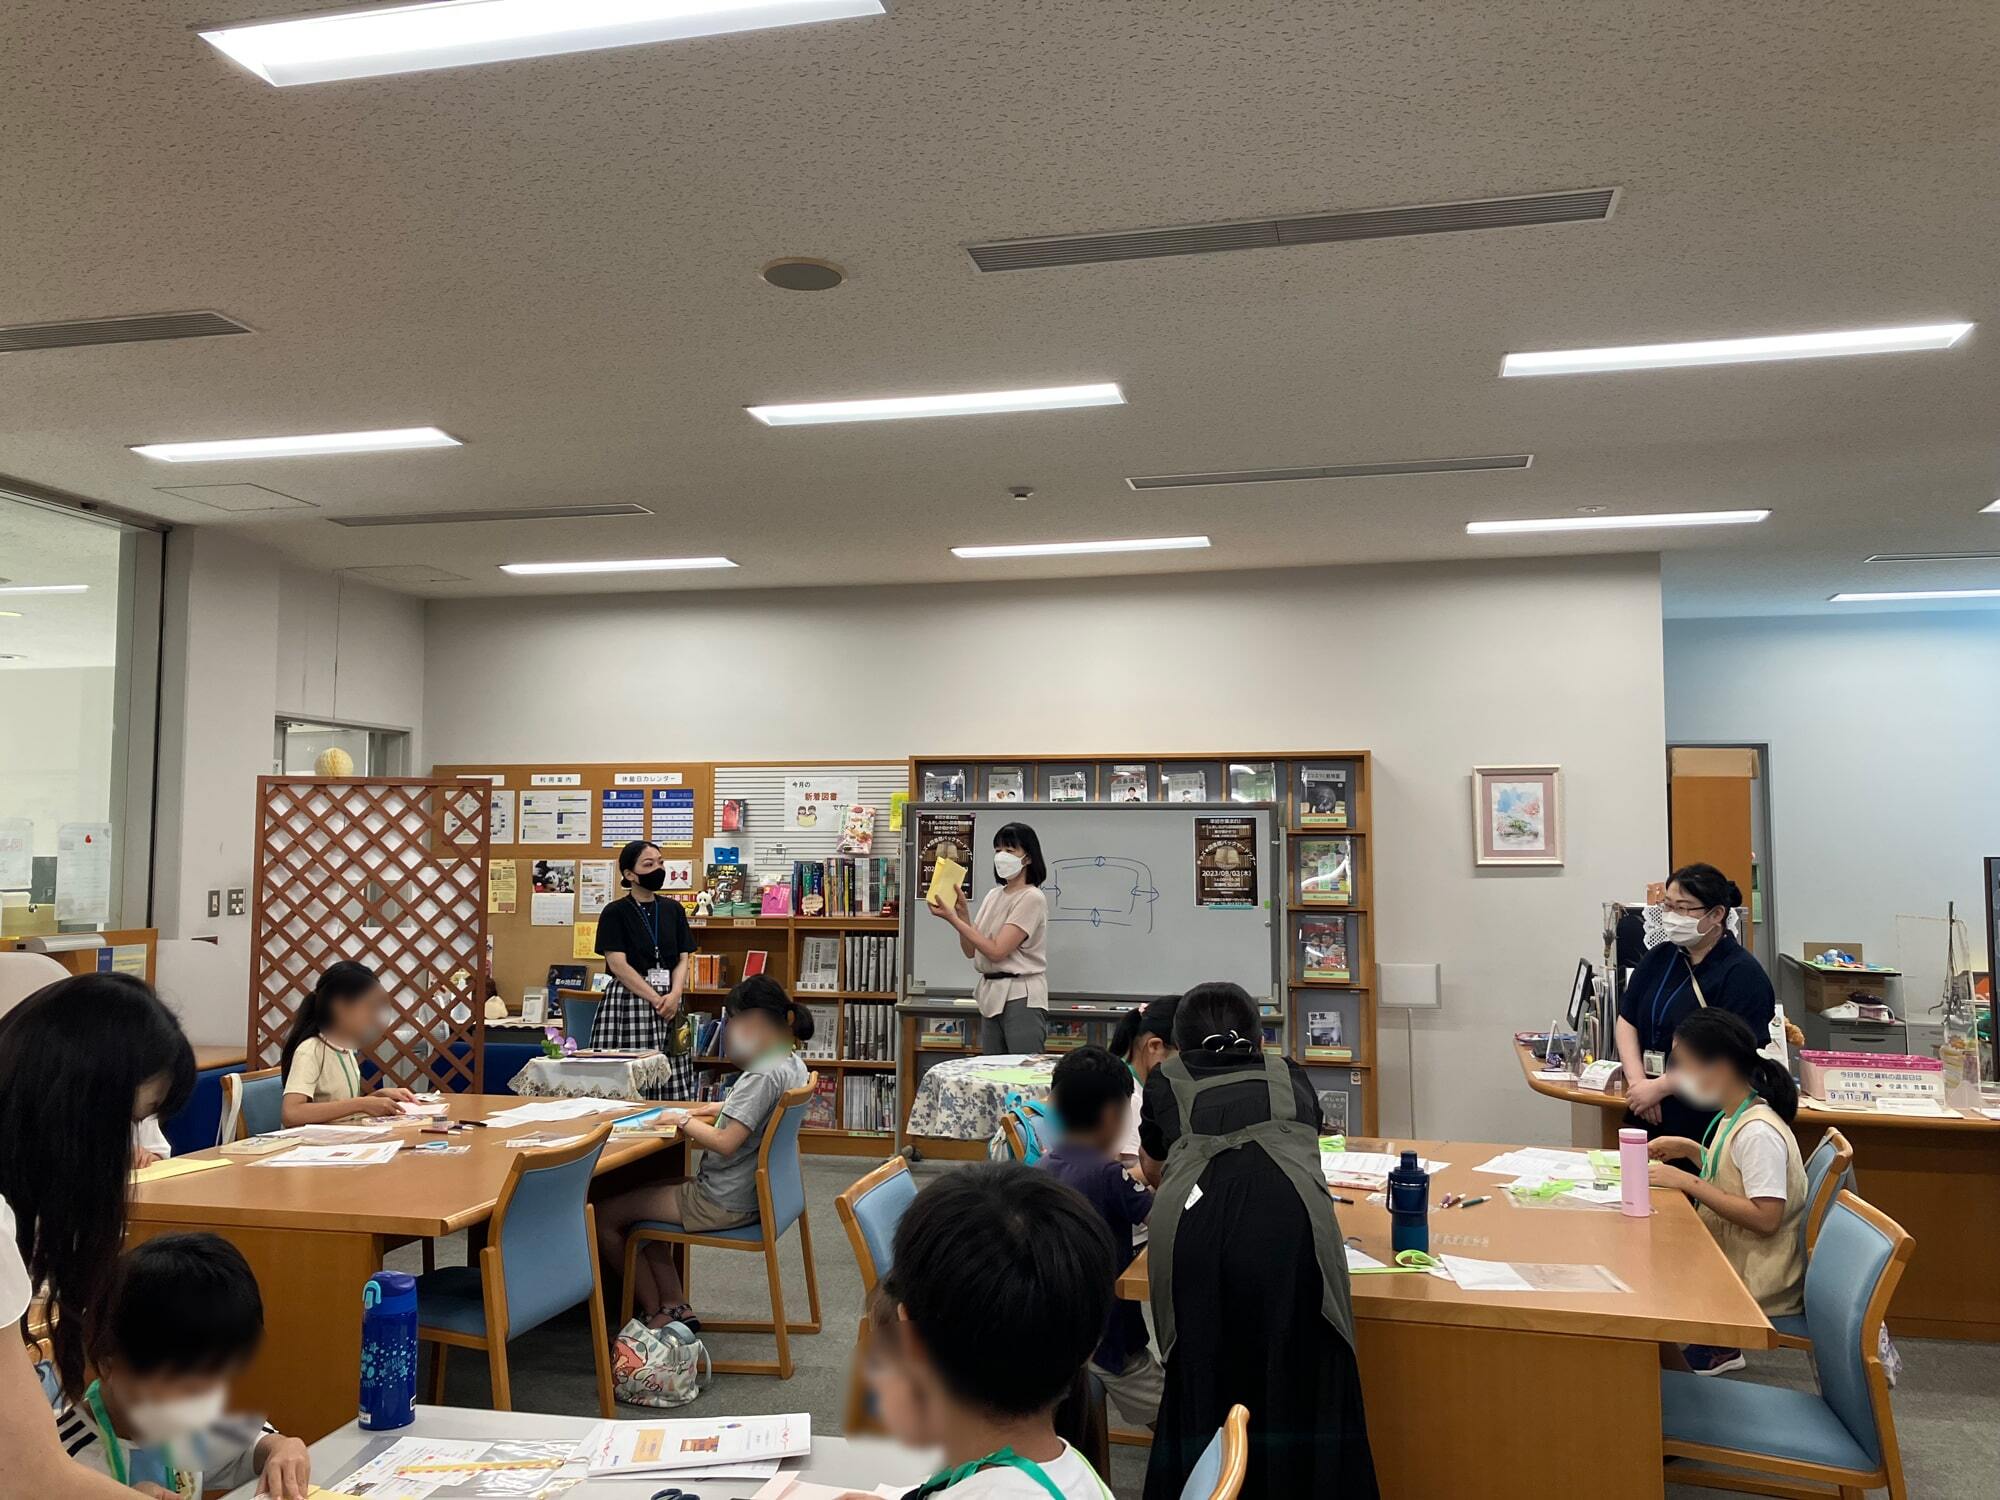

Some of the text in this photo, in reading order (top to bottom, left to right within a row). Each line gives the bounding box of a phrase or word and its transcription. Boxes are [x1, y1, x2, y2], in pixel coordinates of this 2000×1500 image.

[621, 774, 677, 783] 休館日カレンダー
[792, 781, 811, 789] 今月の
[804, 792, 838, 801] 新着図書
